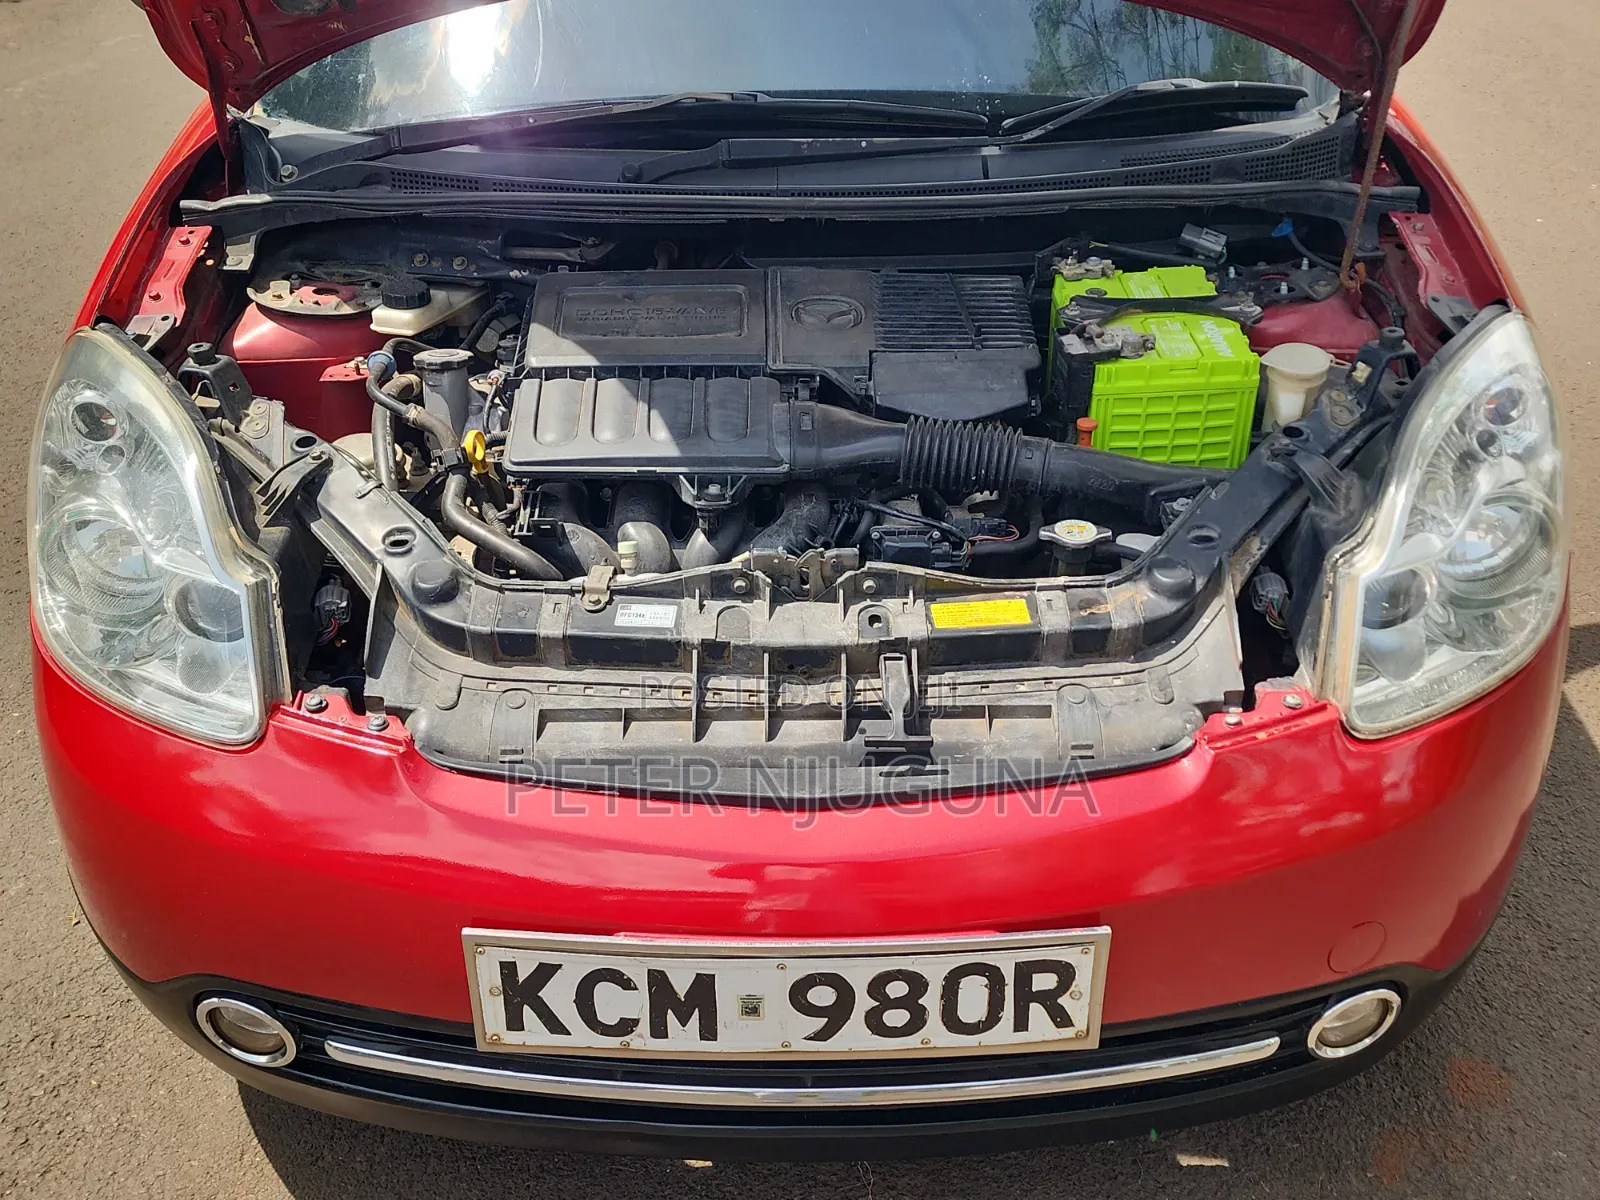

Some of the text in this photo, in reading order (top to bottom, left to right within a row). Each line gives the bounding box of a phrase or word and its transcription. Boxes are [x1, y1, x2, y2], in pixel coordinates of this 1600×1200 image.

[575, 308, 642, 316] DOHC
[498, 958, 1079, 1043] KCM 980R
